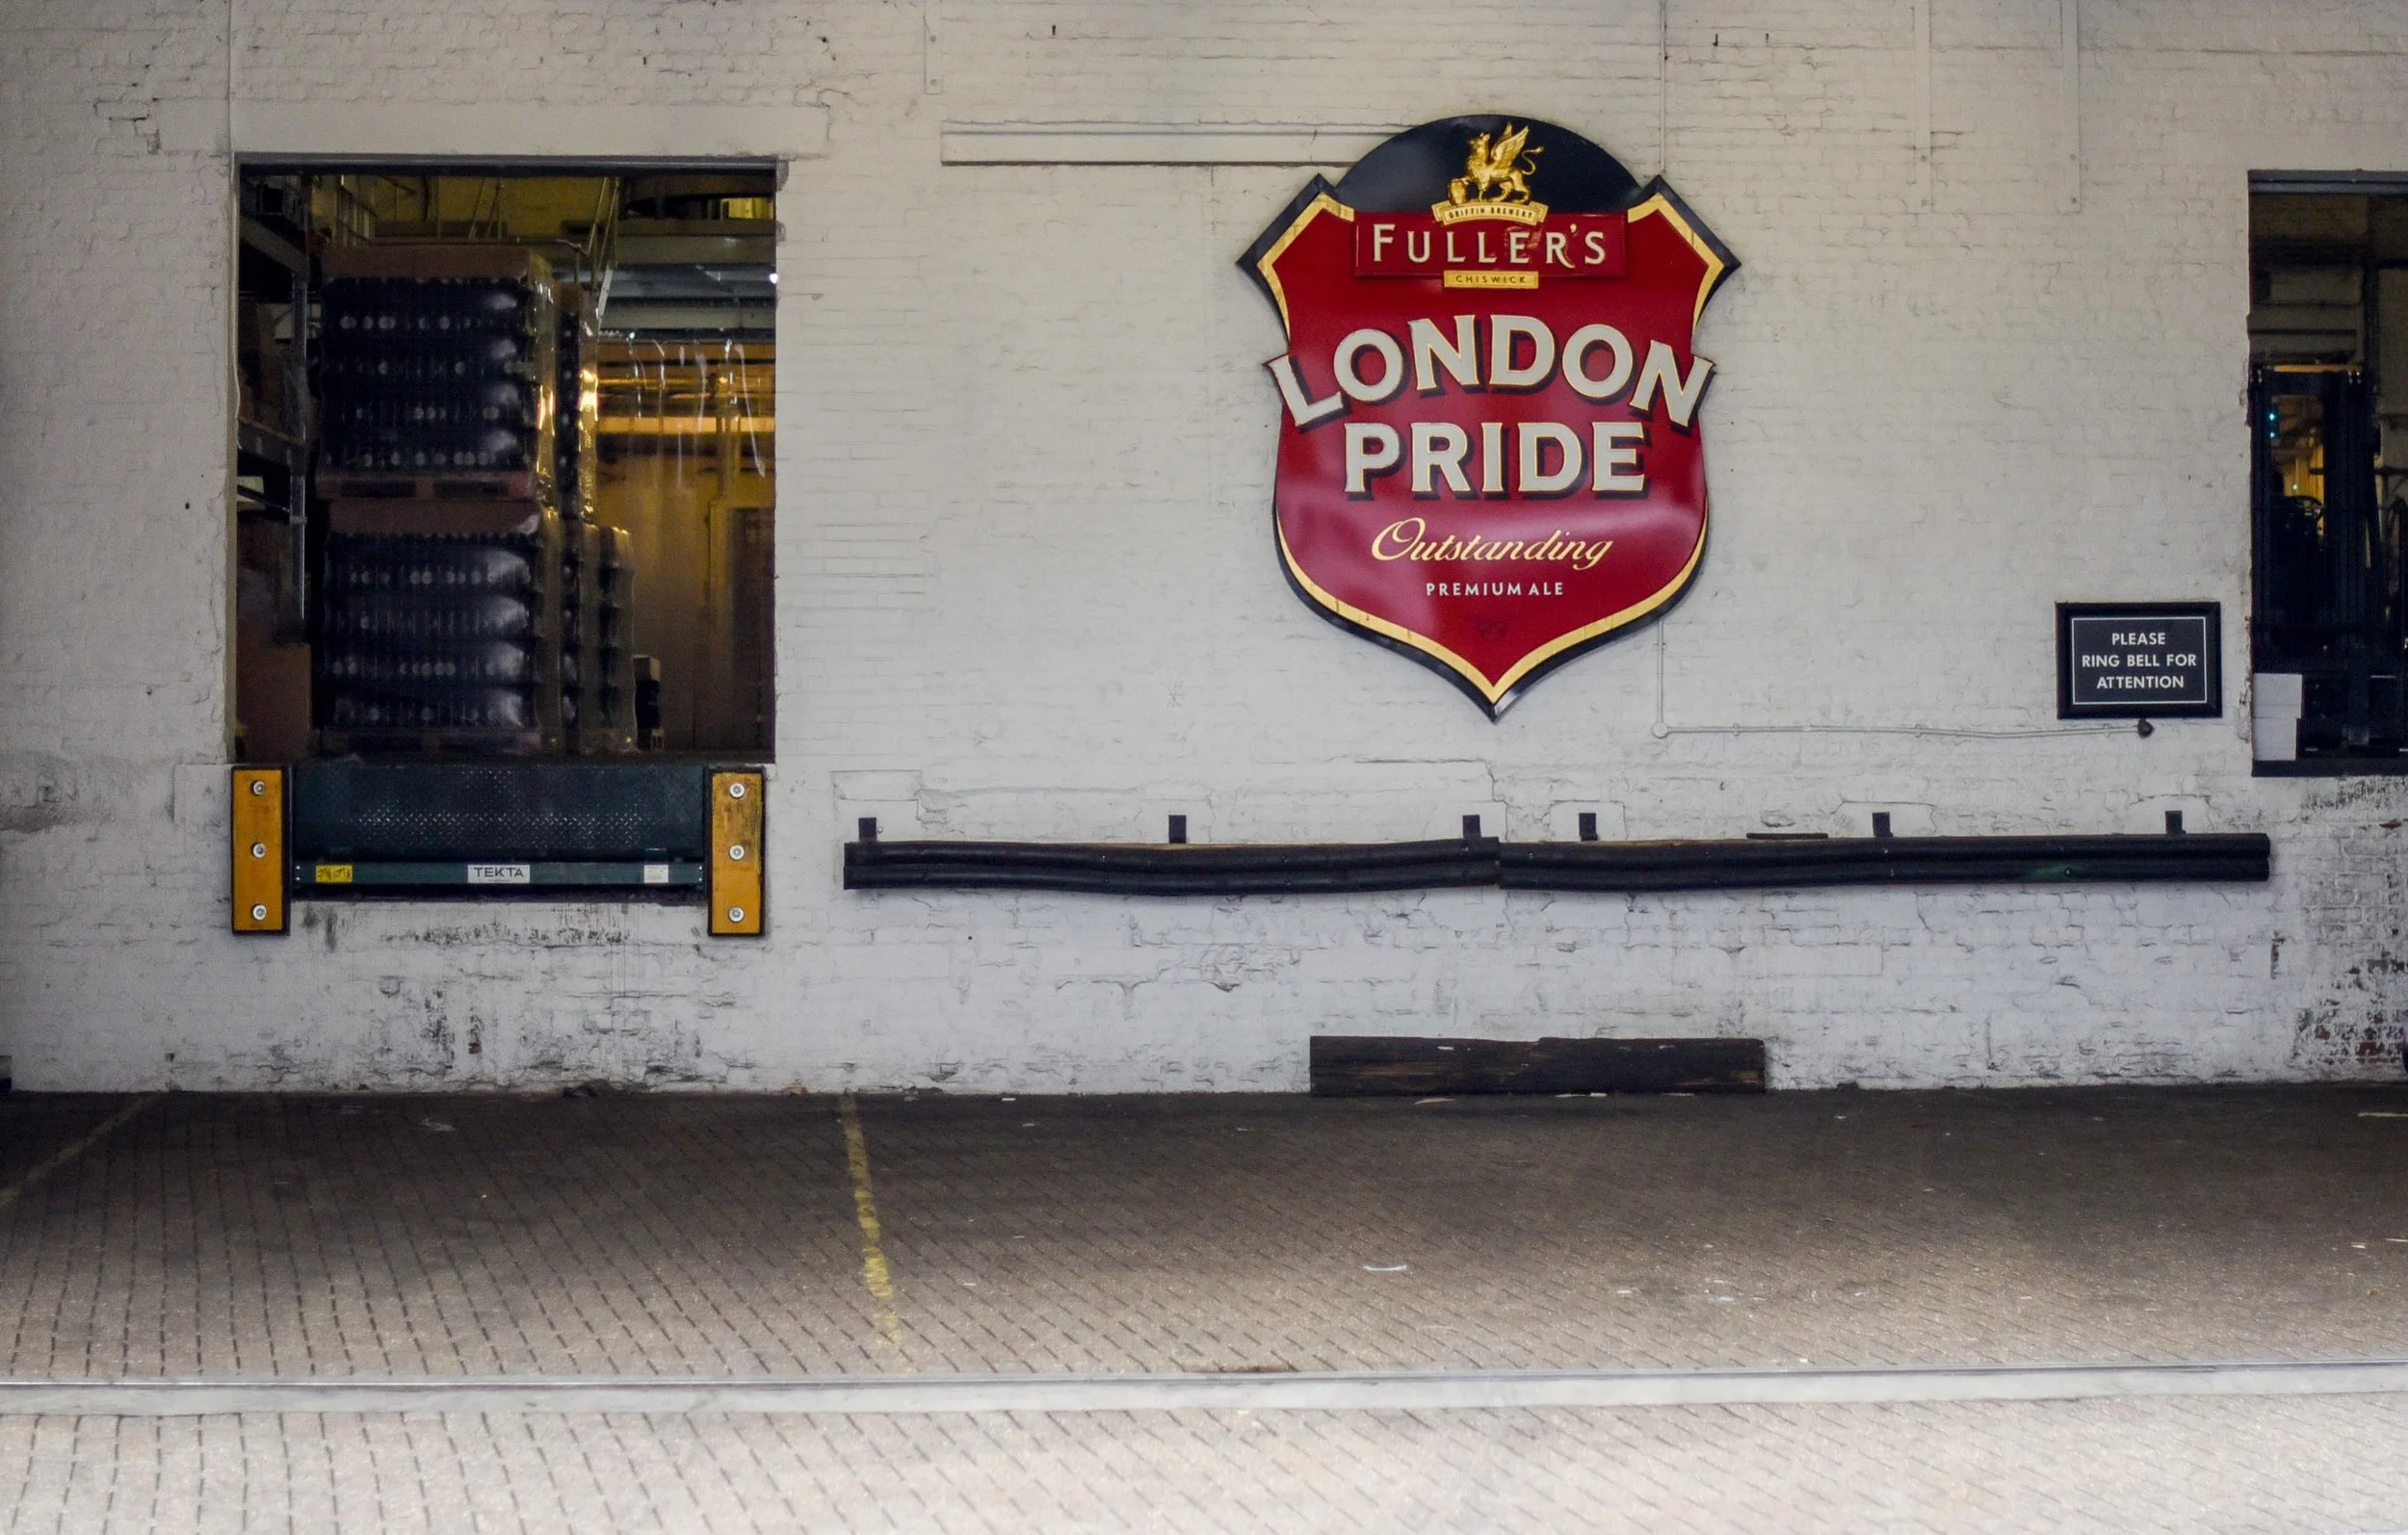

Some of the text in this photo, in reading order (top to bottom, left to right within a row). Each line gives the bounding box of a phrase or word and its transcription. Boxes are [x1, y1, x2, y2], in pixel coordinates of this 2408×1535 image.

[1449, 207, 1532, 219] GRIFFIN BREWERY
[1373, 222, 1606, 269] FULLER'S
[1455, 274, 1526, 284] CHISWICK
[1267, 314, 1715, 429] LONDON
[1344, 422, 1645, 493] PRIDE
[1371, 516, 1613, 571] Outstanding
[1426, 582, 1564, 597] PREMIUM ALE
[2111, 632, 2166, 646] PLEASE
[2081, 654, 2197, 667] RING BELL FOR
[2096, 676, 2185, 689] ATTENTION
[474, 867, 525, 877] TEKTA
